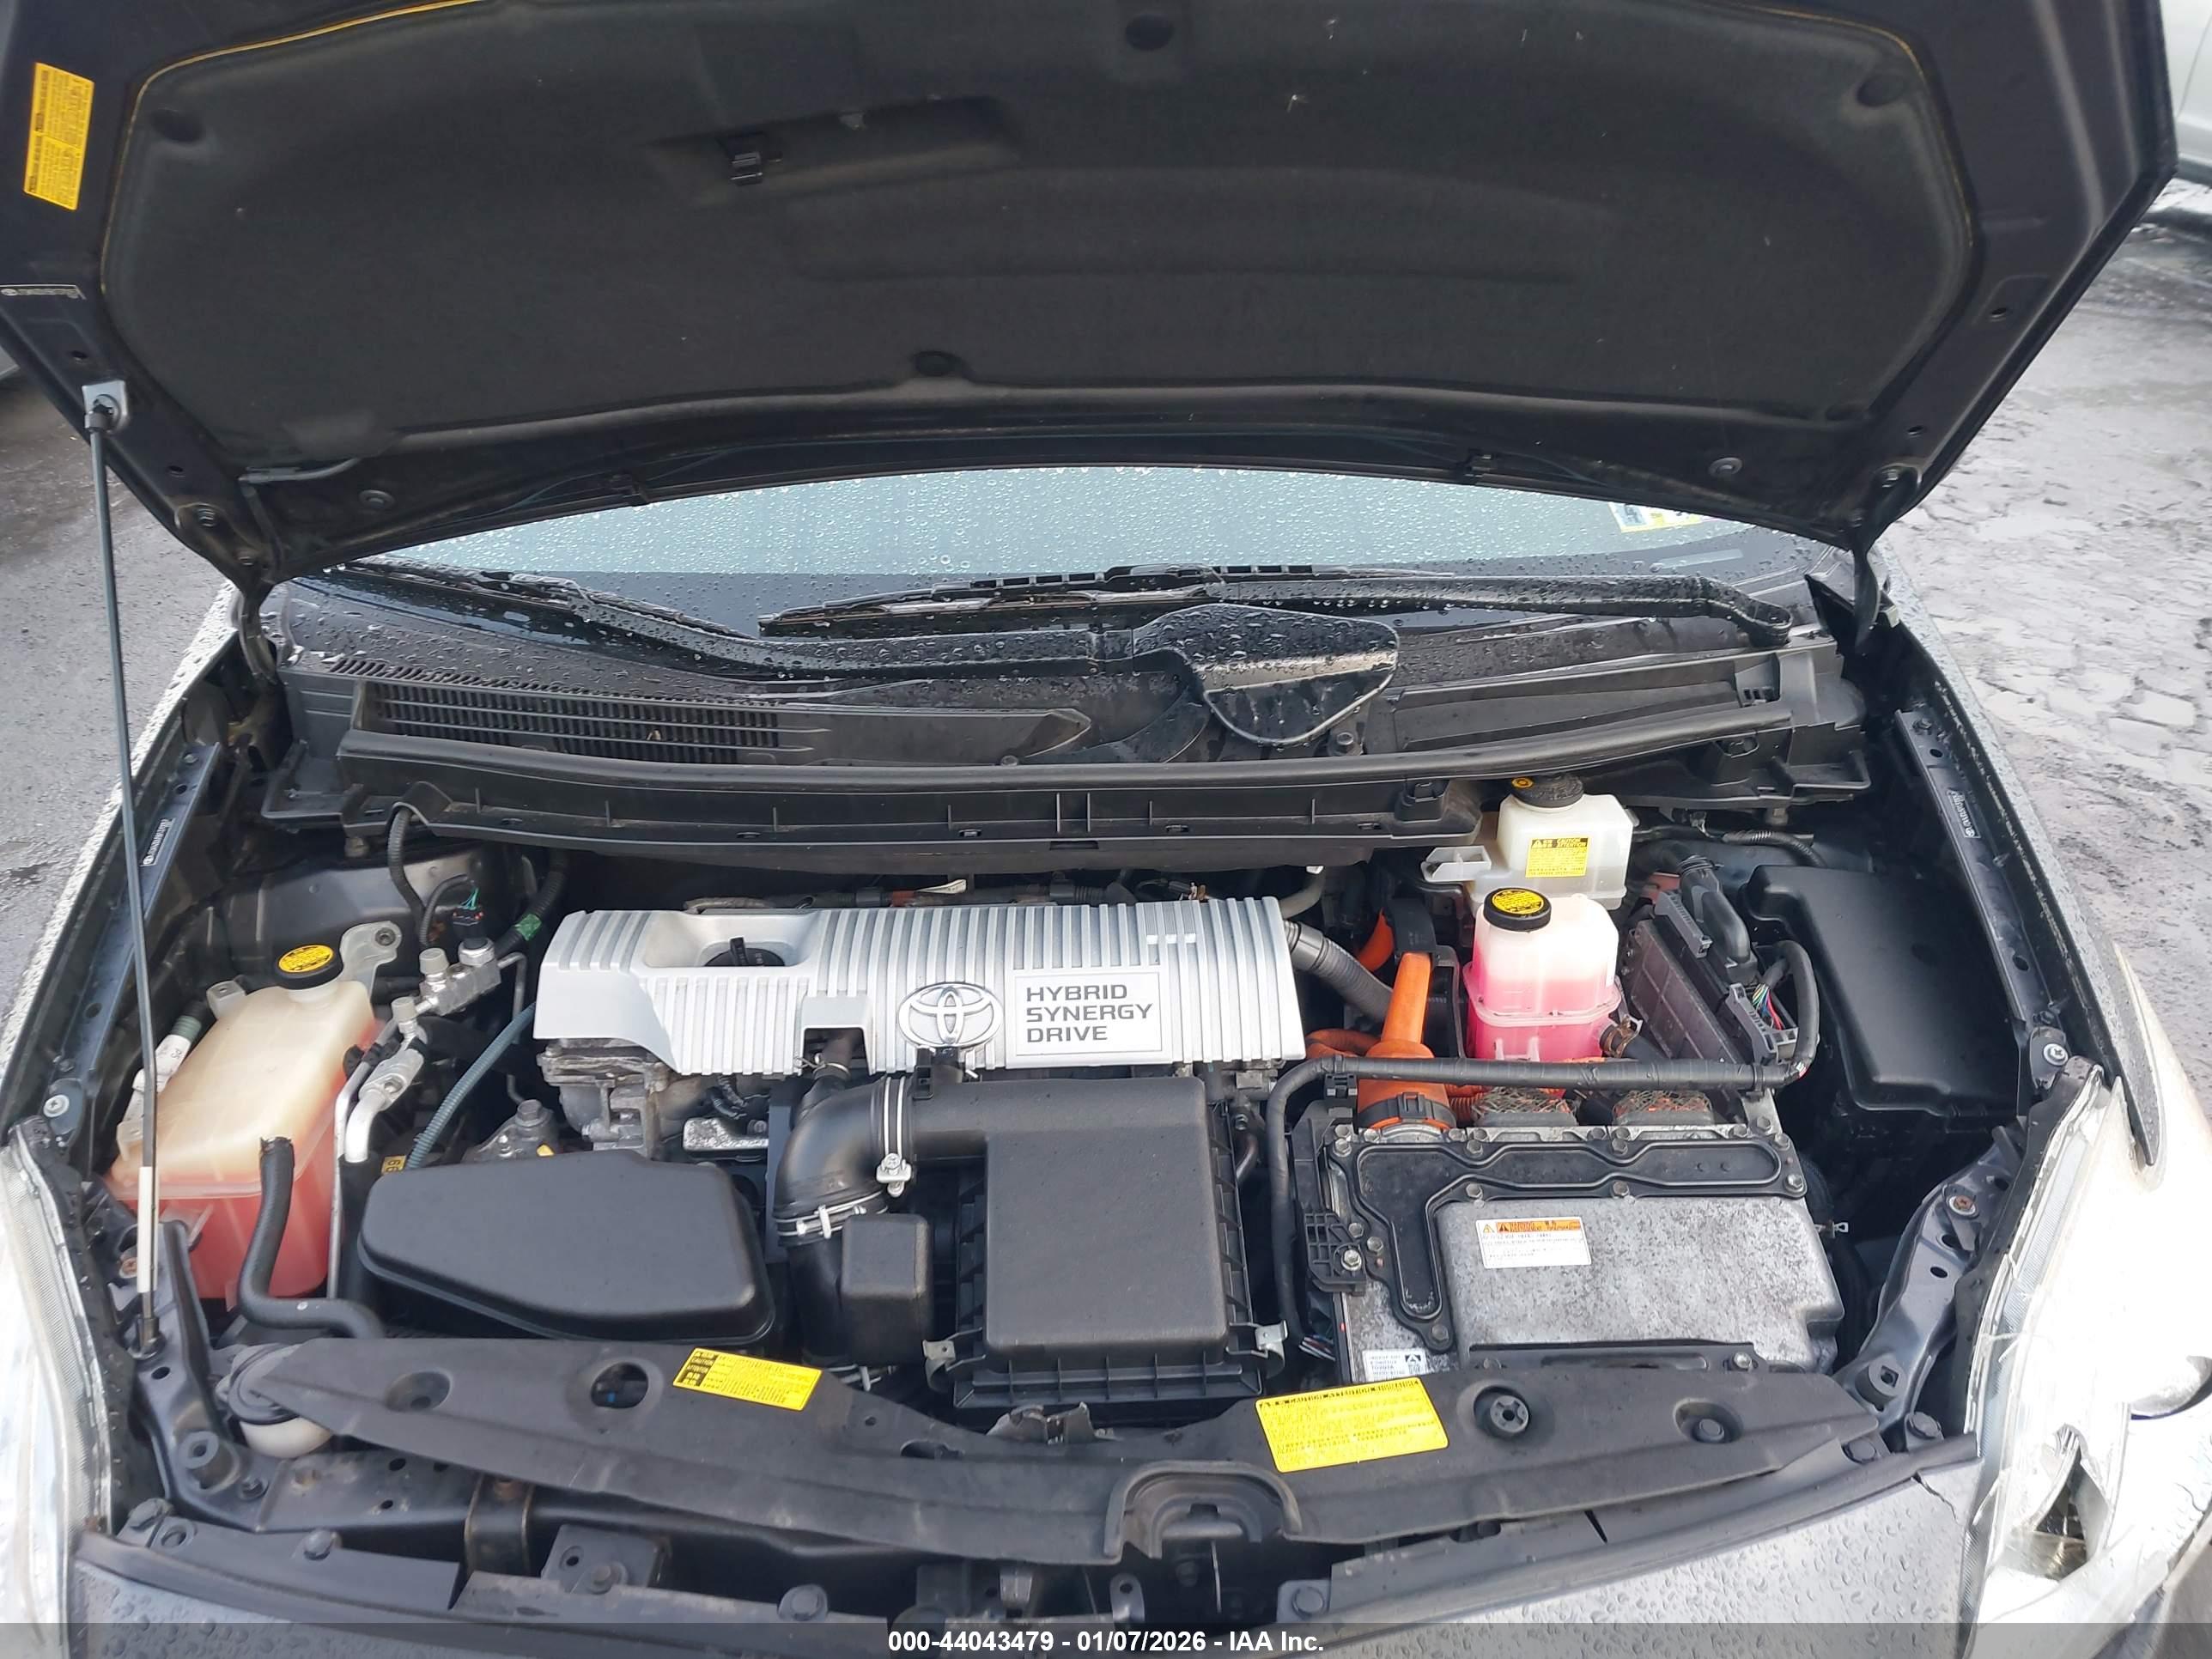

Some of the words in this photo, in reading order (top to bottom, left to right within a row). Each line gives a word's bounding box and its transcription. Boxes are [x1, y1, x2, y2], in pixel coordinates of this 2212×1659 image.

[1026, 984, 1127, 1002] HYBRID
[1026, 1003, 1153, 1022] SYNERGY
[1027, 1025, 1108, 1043] DRIVE
